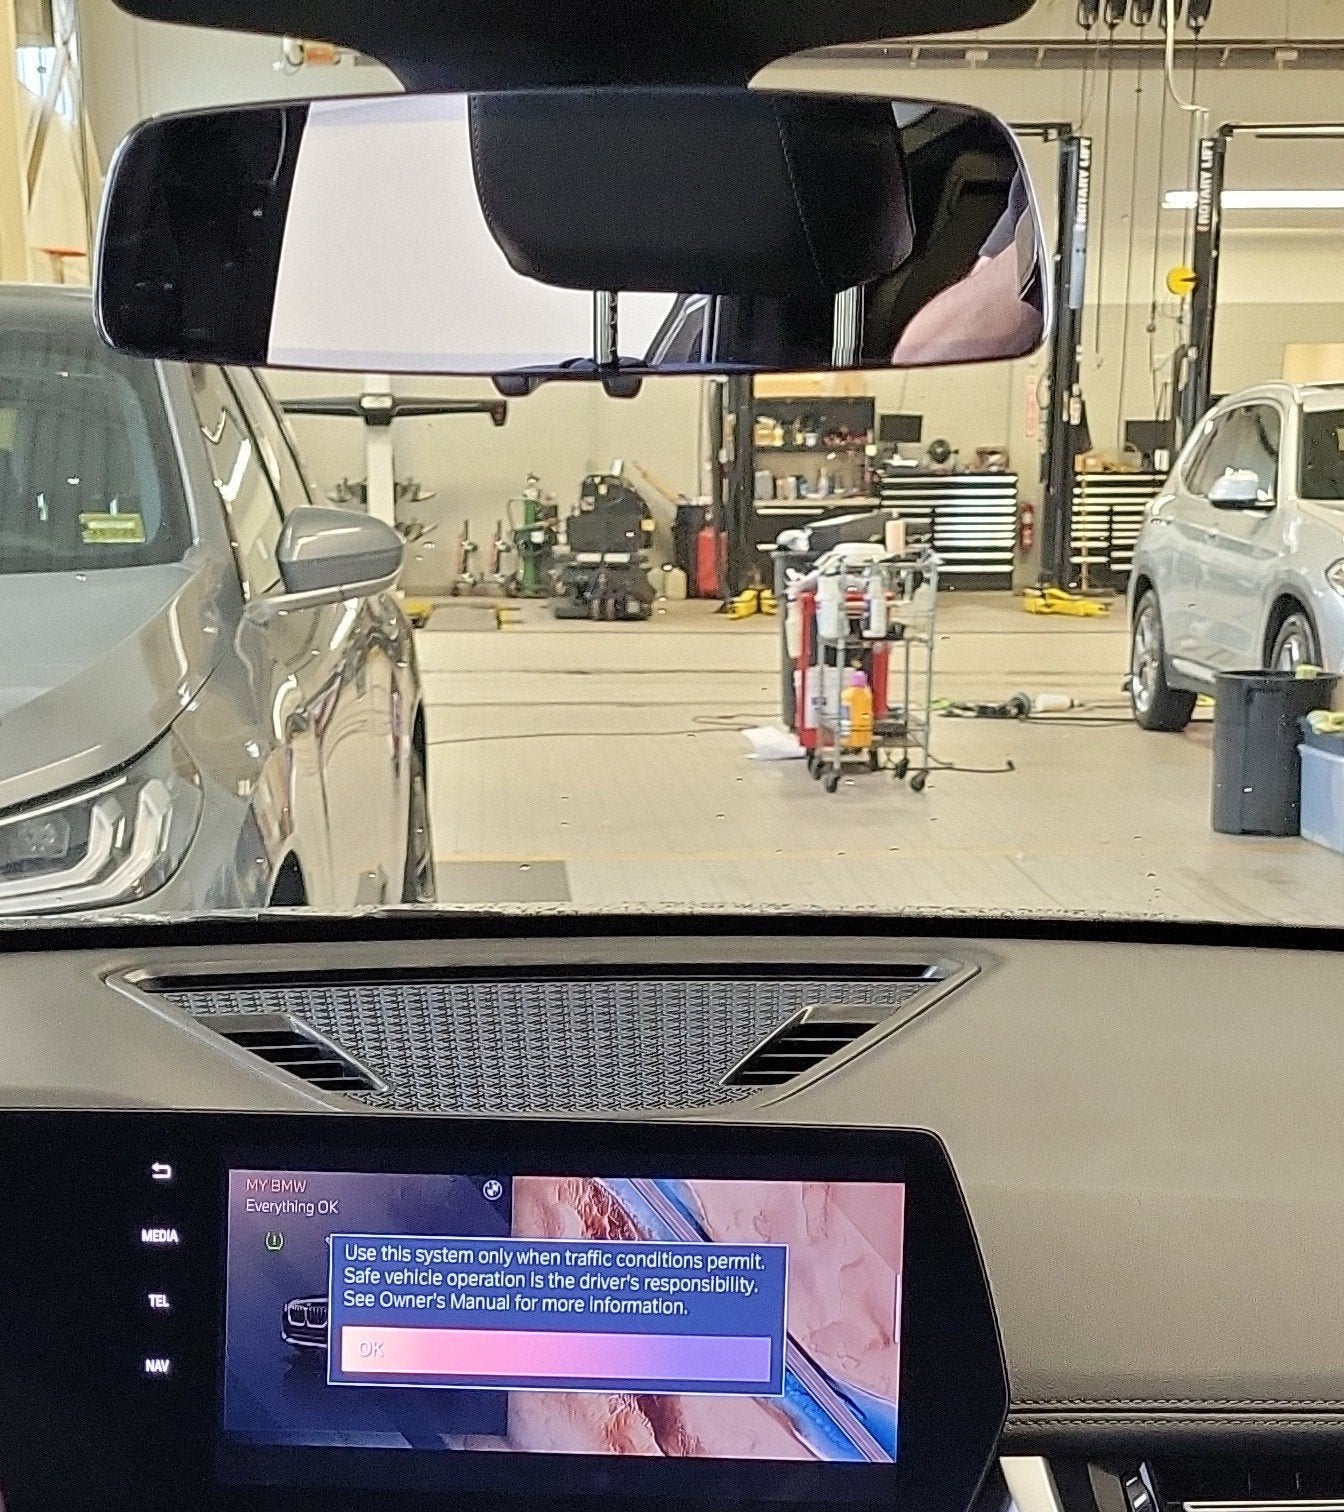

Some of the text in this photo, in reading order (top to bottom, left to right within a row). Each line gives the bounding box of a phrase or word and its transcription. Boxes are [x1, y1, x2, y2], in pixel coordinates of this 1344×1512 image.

[1076, 137, 1091, 224] ROTARY LIFT
[1198, 140, 1215, 224] ROTARY LIFT
[246, 1178, 307, 1193] MY BMW
[246, 1199, 339, 1217] Everything OK
[141, 1228, 179, 1243] MEDIA
[344, 1243, 765, 1272] Use this system only when traffic conditions permit.
[343, 1266, 759, 1297] Safe vehicle operation is the driver's responsibility.
[148, 1293, 170, 1308] TEL
[343, 1289, 689, 1315] See Owner's Manual for more information.
[359, 1341, 385, 1358] OK
[145, 1358, 170, 1373] NAV
